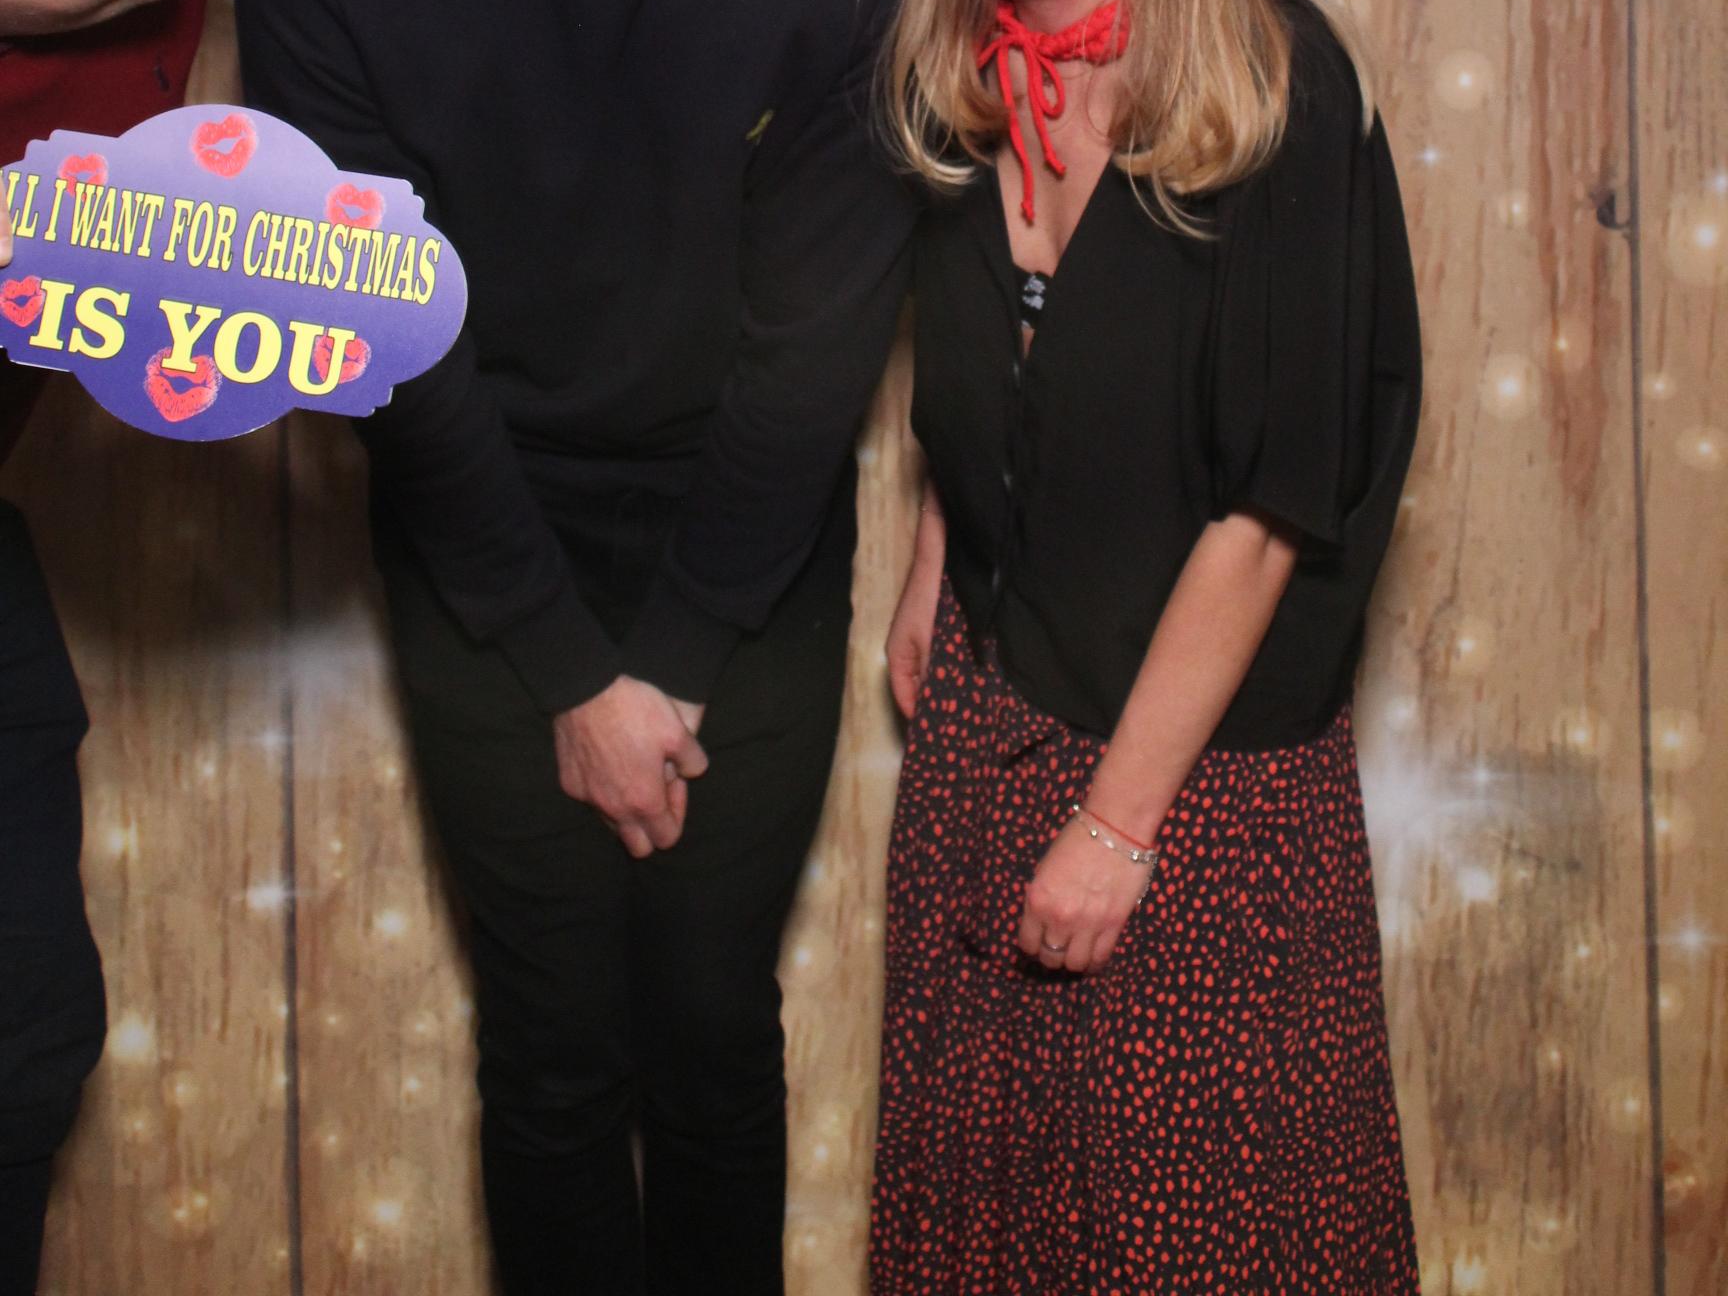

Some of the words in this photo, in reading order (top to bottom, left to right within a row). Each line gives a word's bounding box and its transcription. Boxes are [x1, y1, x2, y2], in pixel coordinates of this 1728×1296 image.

[0, 169, 40, 238] LL
[44, 178, 68, 242] I
[70, 182, 164, 258] WANT
[163, 198, 238, 272] FOR
[242, 210, 442, 305] CHRISTMAS
[28, 279, 131, 360] IS
[158, 298, 356, 396] YOU
